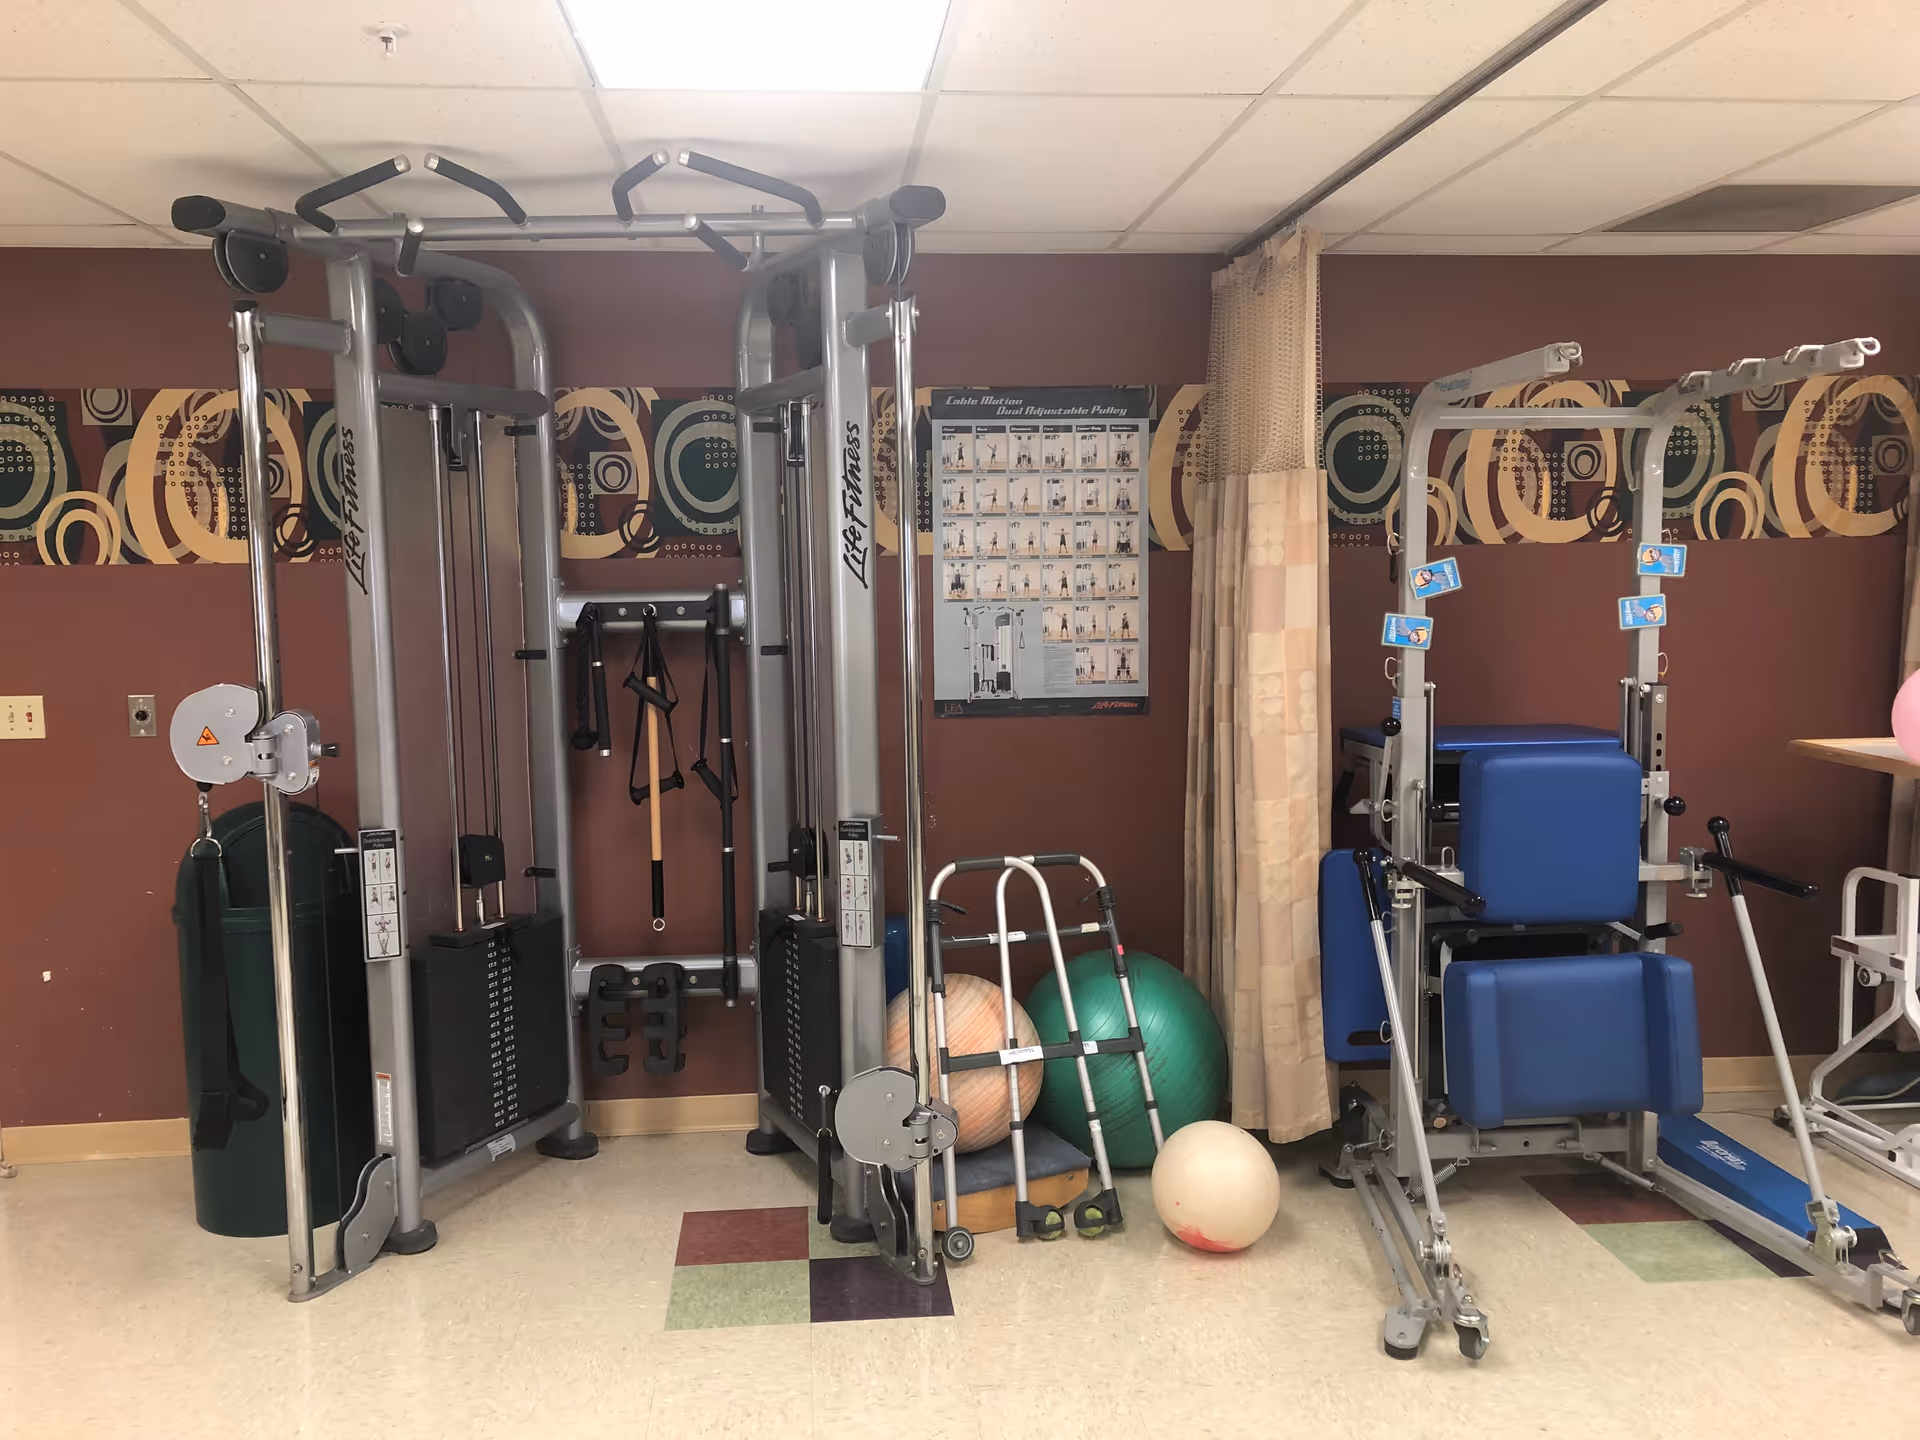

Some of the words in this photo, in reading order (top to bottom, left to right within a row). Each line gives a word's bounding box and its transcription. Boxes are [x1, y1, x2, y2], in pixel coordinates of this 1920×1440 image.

[946, 396, 978, 406] Cable
[980, 396, 1023, 405] Motion
[996, 406, 1024, 415] Dual
[1025, 405, 1088, 417] Adjustable
[1091, 405, 1127, 416] Pulley
